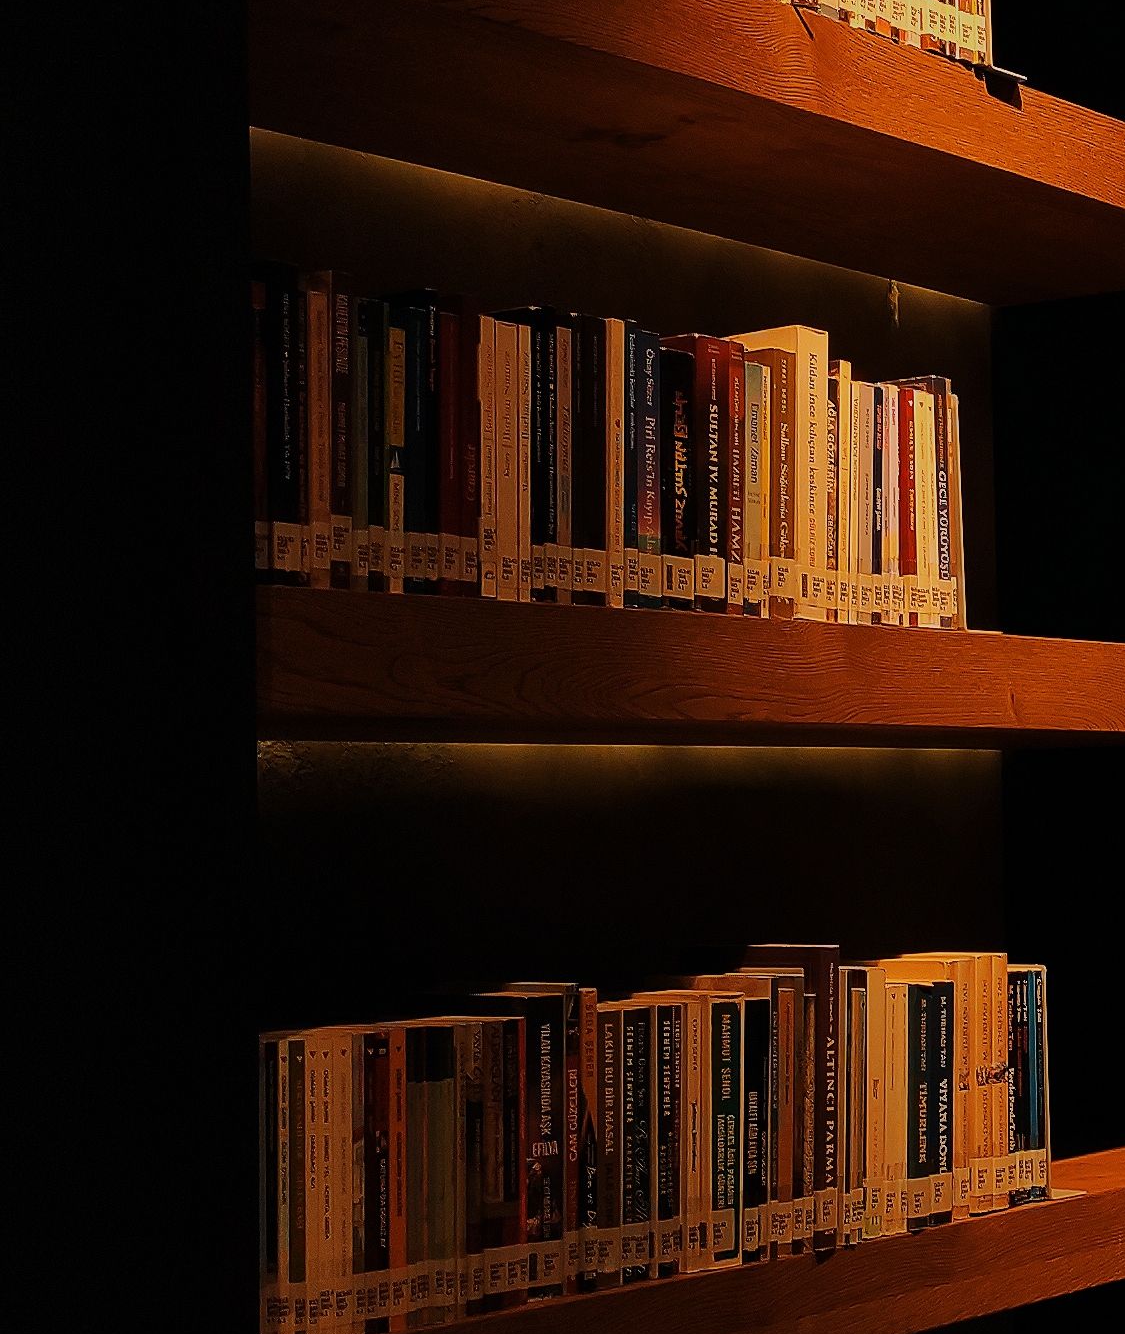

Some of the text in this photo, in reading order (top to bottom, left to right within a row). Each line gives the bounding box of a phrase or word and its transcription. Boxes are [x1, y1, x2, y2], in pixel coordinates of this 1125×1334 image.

[708, 403, 718, 463] SULTAN
[708, 486, 718, 543] MURAD
[731, 506, 741, 563] HAMZ
[720, 1012, 731, 1064] MAHMUT
[825, 1034, 835, 1188] ALTINCI PARMA
